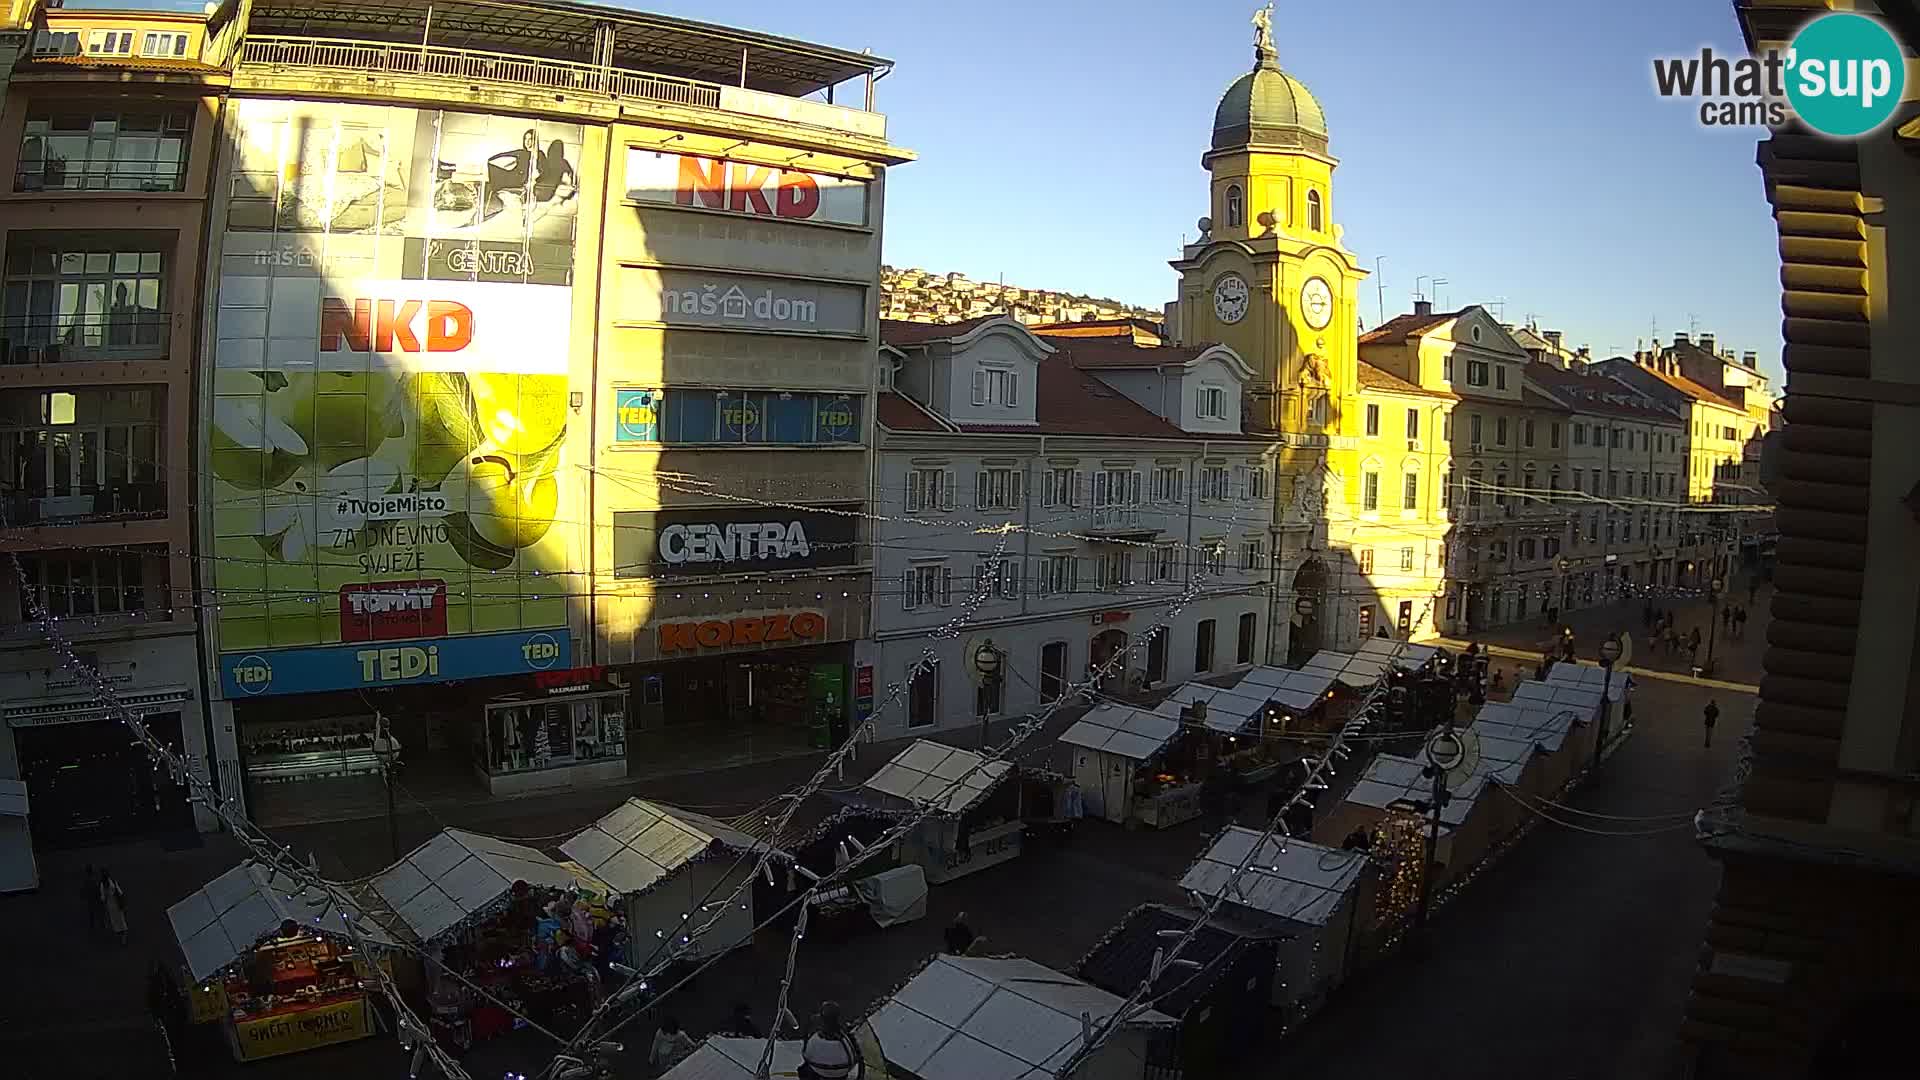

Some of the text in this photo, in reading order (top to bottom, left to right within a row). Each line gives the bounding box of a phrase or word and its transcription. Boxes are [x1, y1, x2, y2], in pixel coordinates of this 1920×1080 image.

[676, 157, 820, 219] NKD
[447, 248, 535, 275] CENTRA
[661, 283, 817, 323] naš dom
[320, 298, 473, 352] NKD
[723, 410, 759, 425] TEDi
[820, 411, 853, 427] TEDi
[337, 497, 446, 516] #TvojeMisto
[333, 524, 449, 549] ZA DNEVNO
[659, 521, 810, 564] CENTRA
[359, 547, 424, 575] SVJEŽE
[348, 586, 437, 614] TOMMY
[658, 612, 826, 654] KORZO
[357, 646, 440, 682] TEDi
[521, 643, 559, 660] TEDi
[232, 666, 273, 683] TEDi
